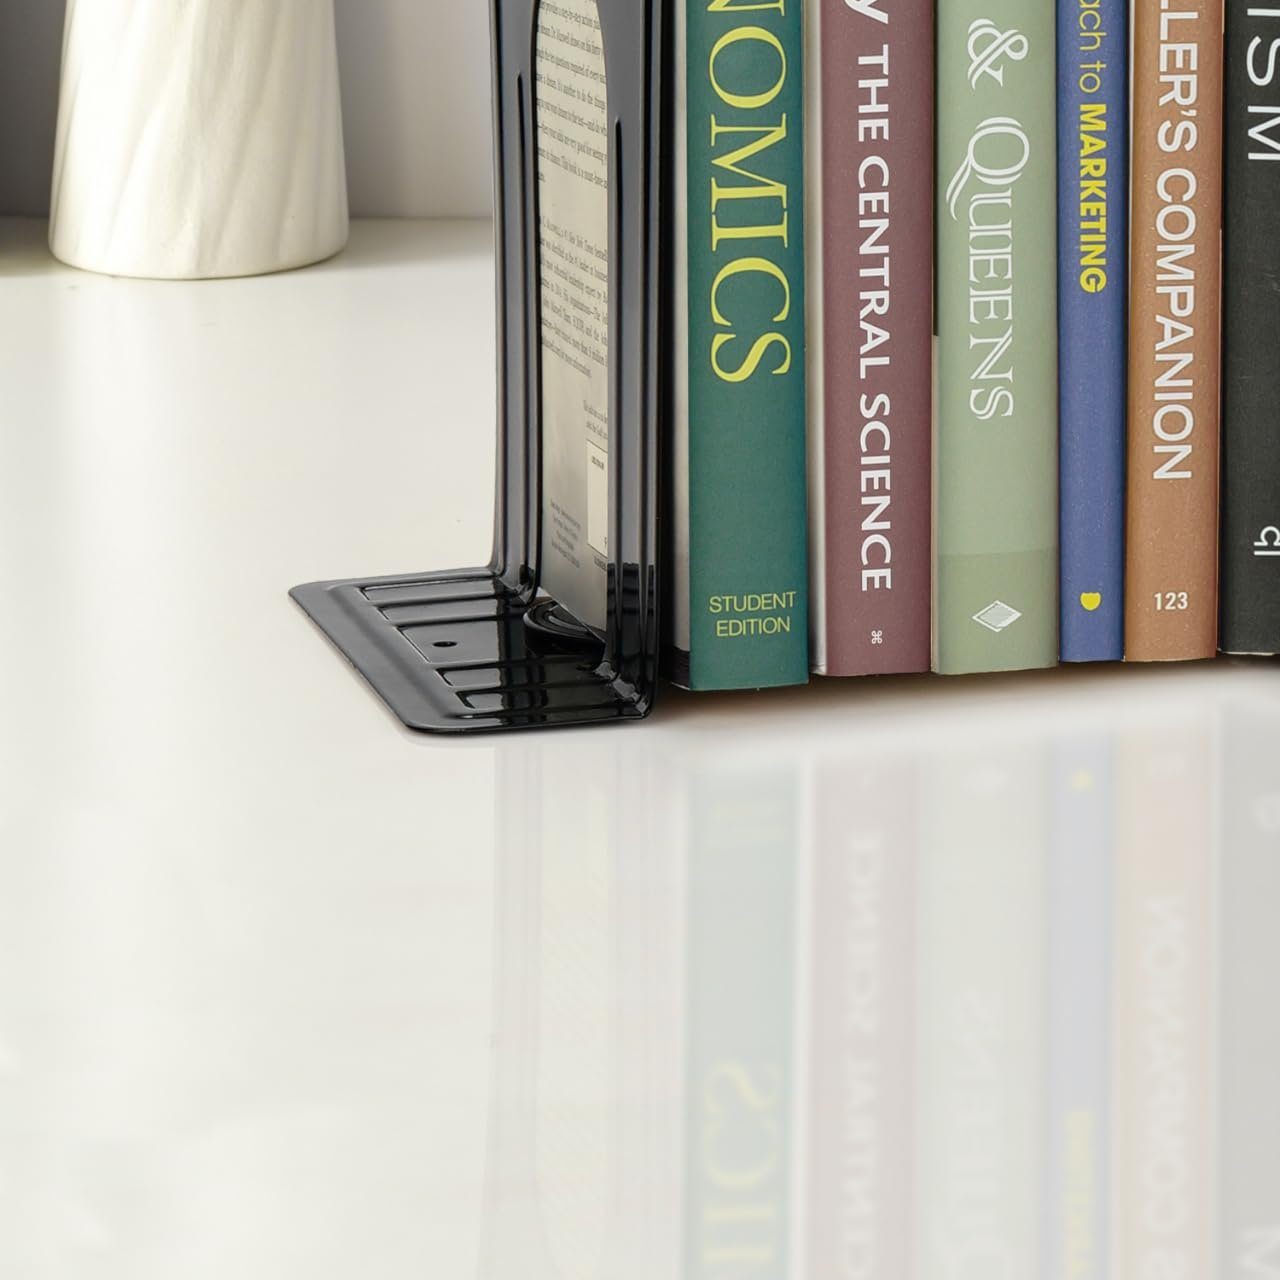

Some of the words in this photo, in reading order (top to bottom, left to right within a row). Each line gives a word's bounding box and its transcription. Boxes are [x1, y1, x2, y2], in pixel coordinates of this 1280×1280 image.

[857, 43, 890, 143] THE
[967, 18, 1030, 90] &
[1077, 60, 1106, 94] to
[1078, 102, 1108, 294] MARKETING
[858, 154, 891, 380] CENTRAL
[1152, 167, 1197, 480] COMPANION
[859, 392, 892, 592] SCIENCE
[708, 591, 795, 613] STUDENT
[715, 616, 792, 637] EDITION
[1154, 591, 1189, 611] 123
